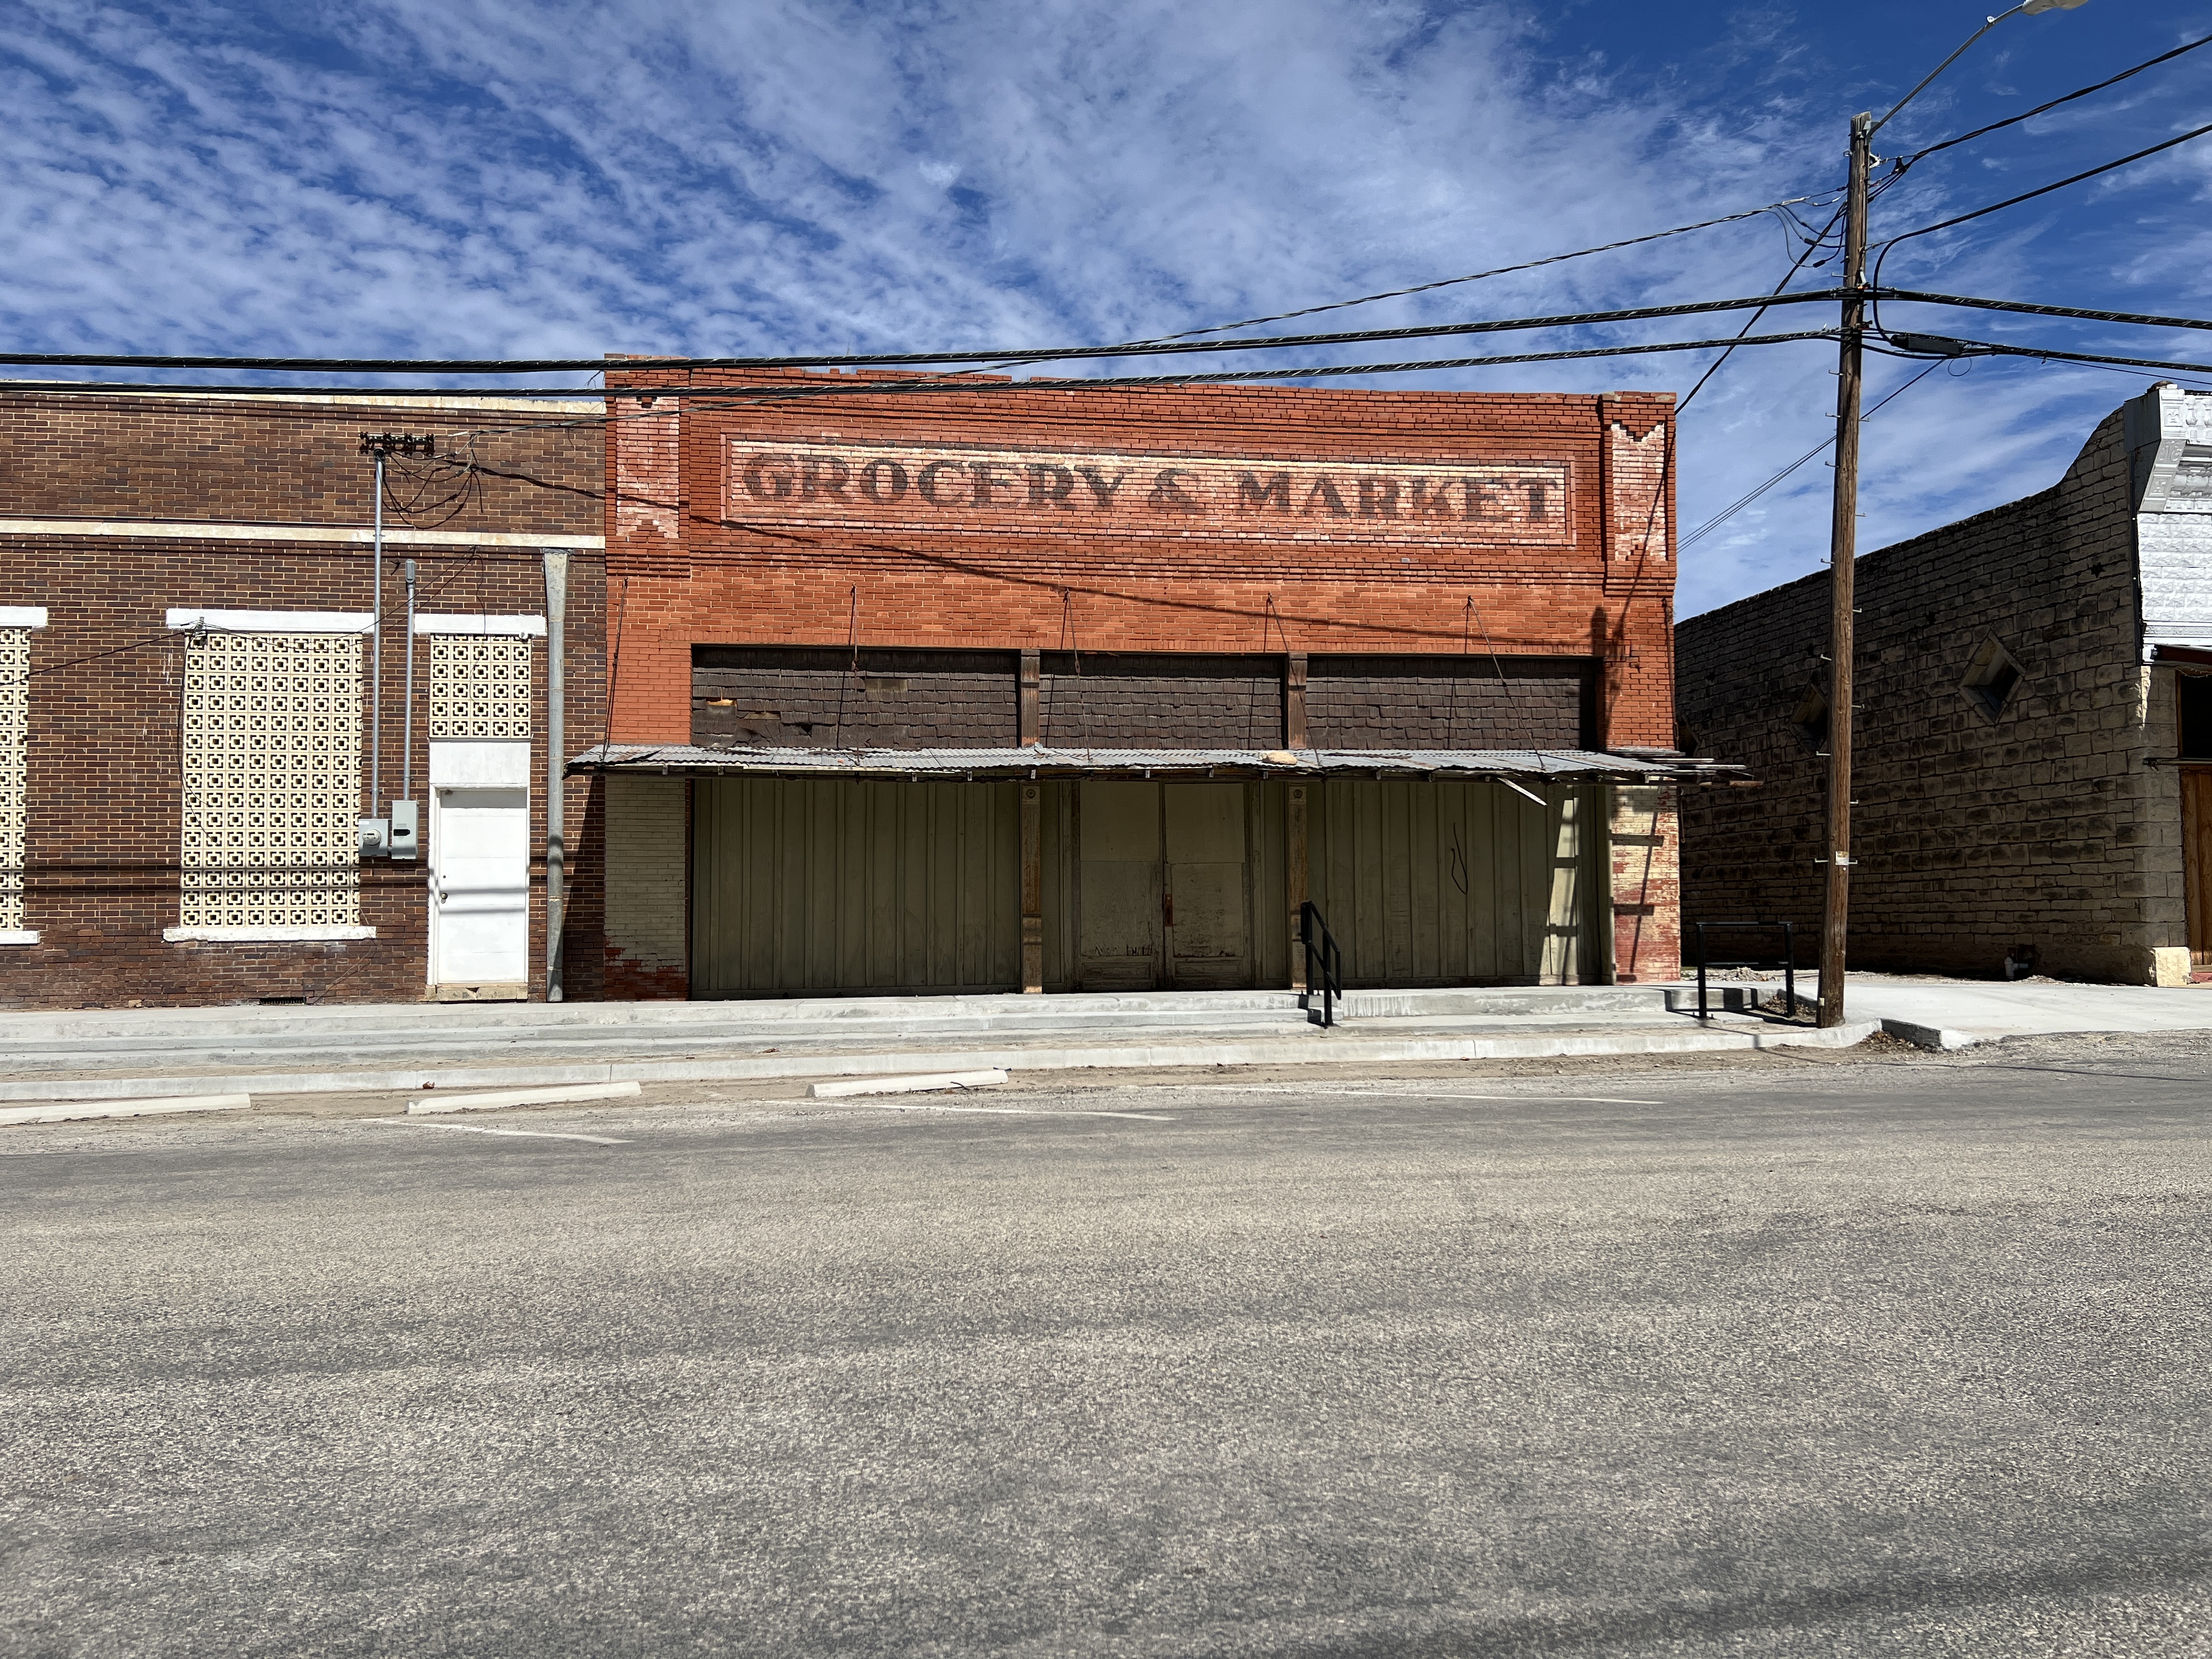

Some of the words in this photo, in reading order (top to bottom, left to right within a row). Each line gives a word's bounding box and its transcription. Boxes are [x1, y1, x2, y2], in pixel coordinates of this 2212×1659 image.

[743, 454, 1132, 512] GROCERY
[1148, 469, 1206, 514] &
[1234, 472, 1559, 522] MARKET
